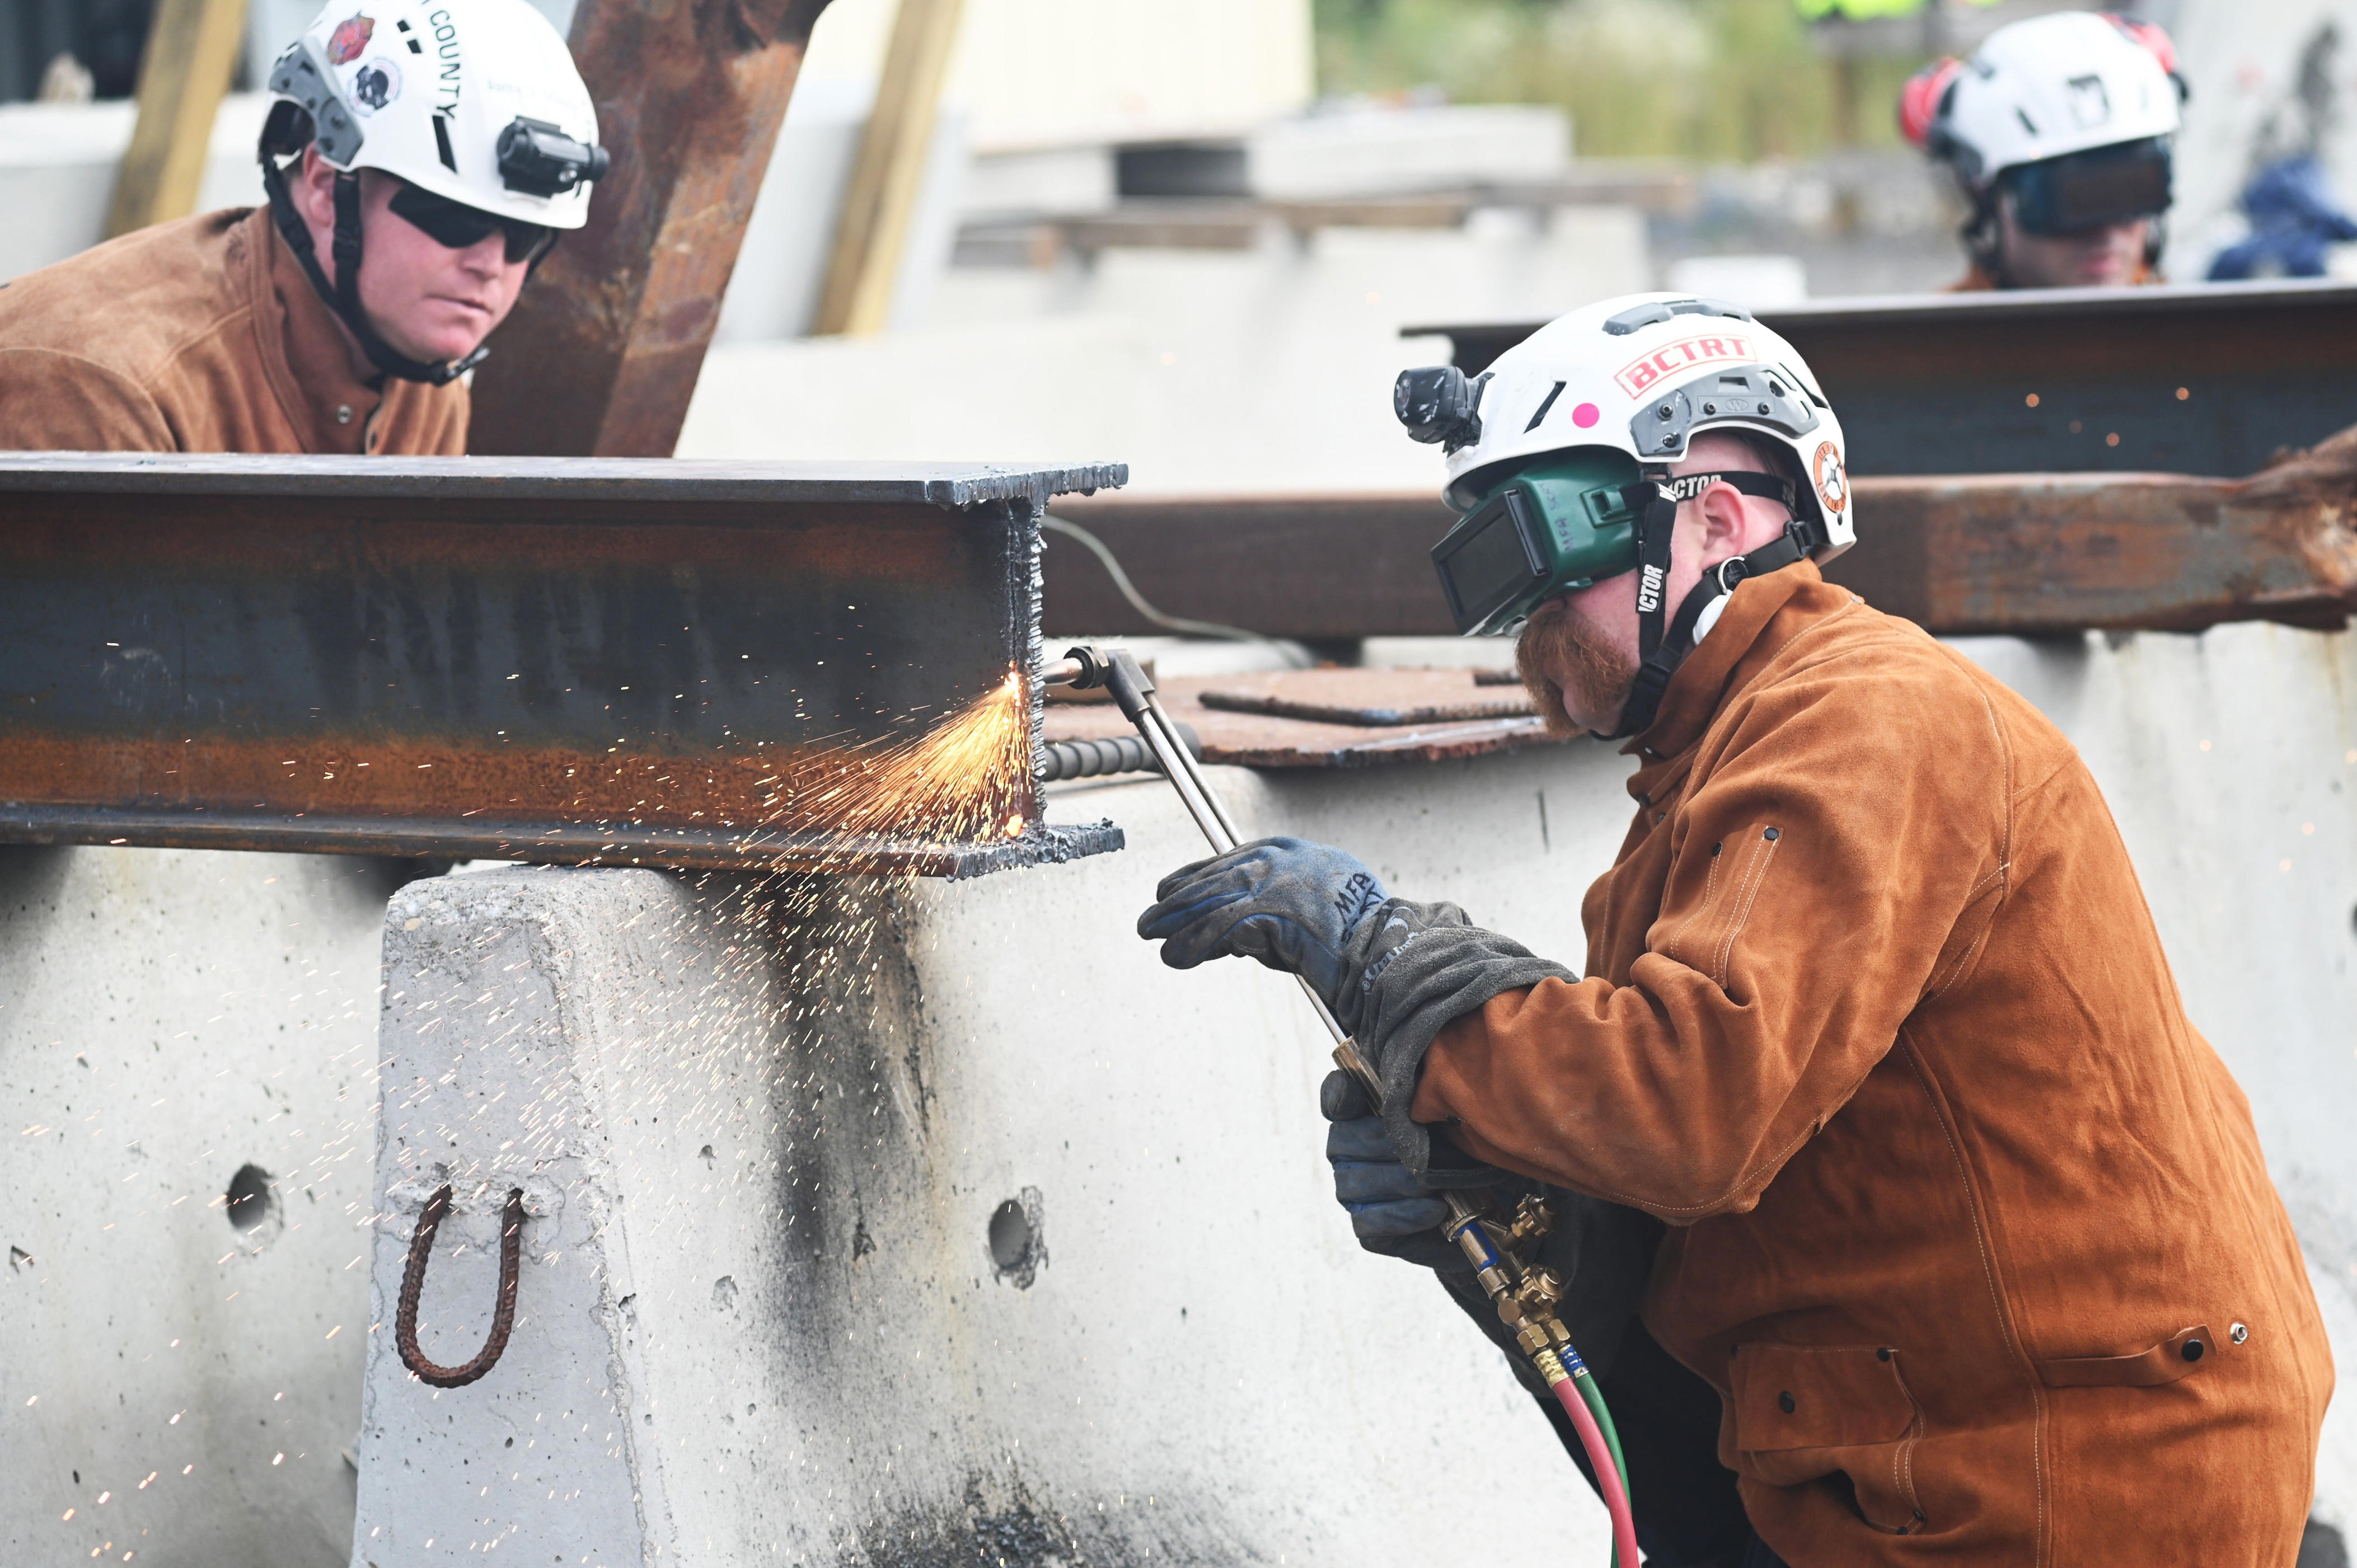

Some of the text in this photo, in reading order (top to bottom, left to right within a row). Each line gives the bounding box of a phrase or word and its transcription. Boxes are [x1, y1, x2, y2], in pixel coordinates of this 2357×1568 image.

[430, 10, 460, 119] COUNTY
[1625, 338, 1746, 390] BCTRT
[1334, 872, 1371, 924] MFA
